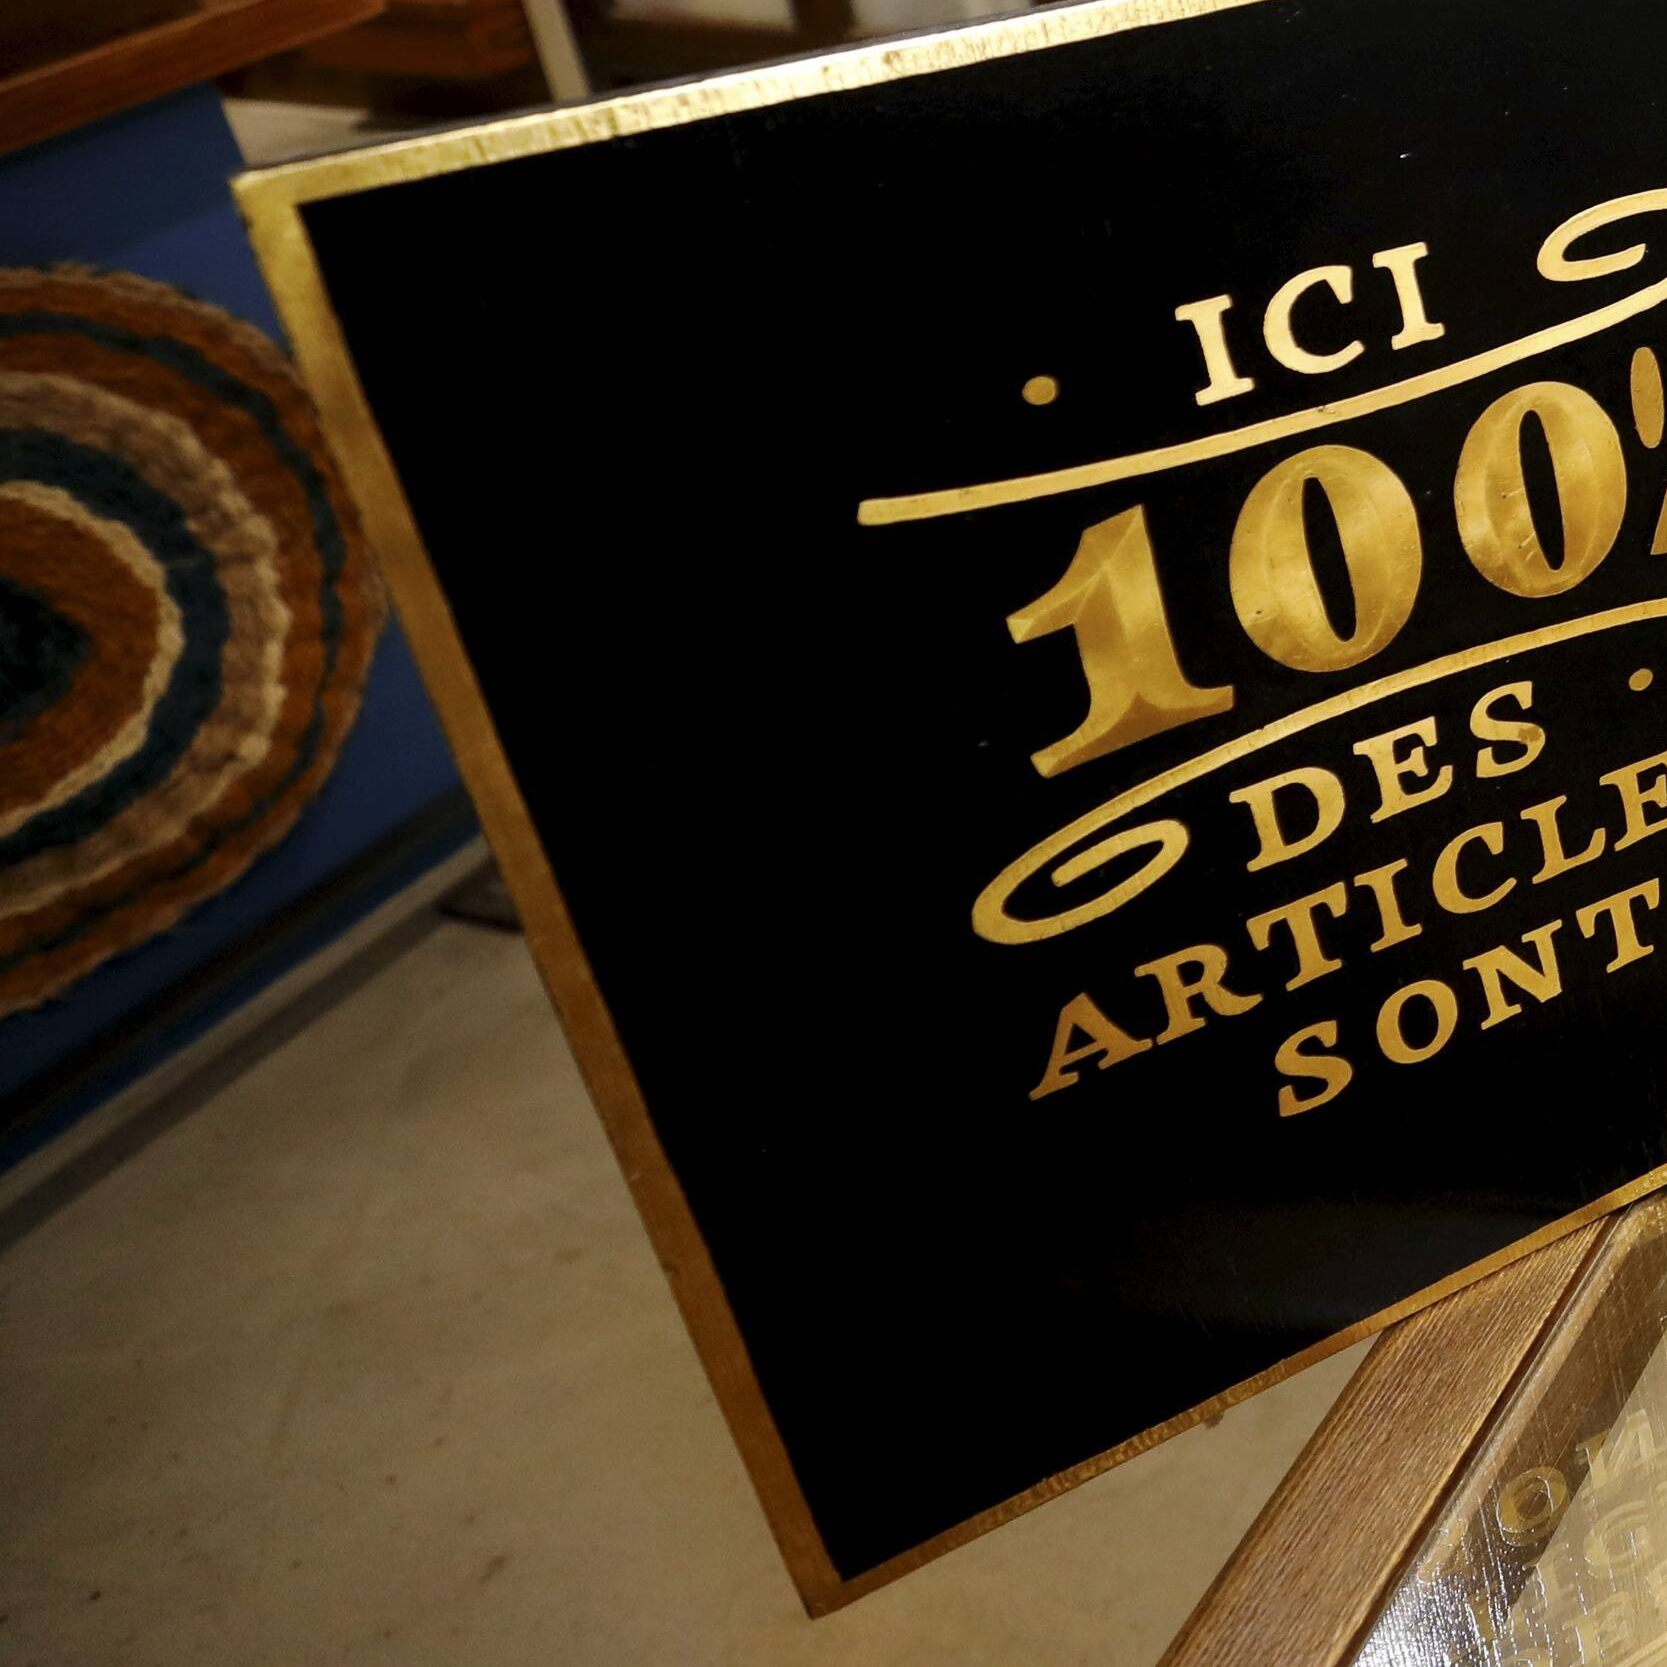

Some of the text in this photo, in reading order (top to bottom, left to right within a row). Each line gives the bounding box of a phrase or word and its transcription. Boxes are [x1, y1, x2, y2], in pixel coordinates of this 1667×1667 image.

[1175, 242, 1445, 406] ICI
[1229, 680, 1545, 872] DES
[1275, 878, 1660, 1116] SONT
